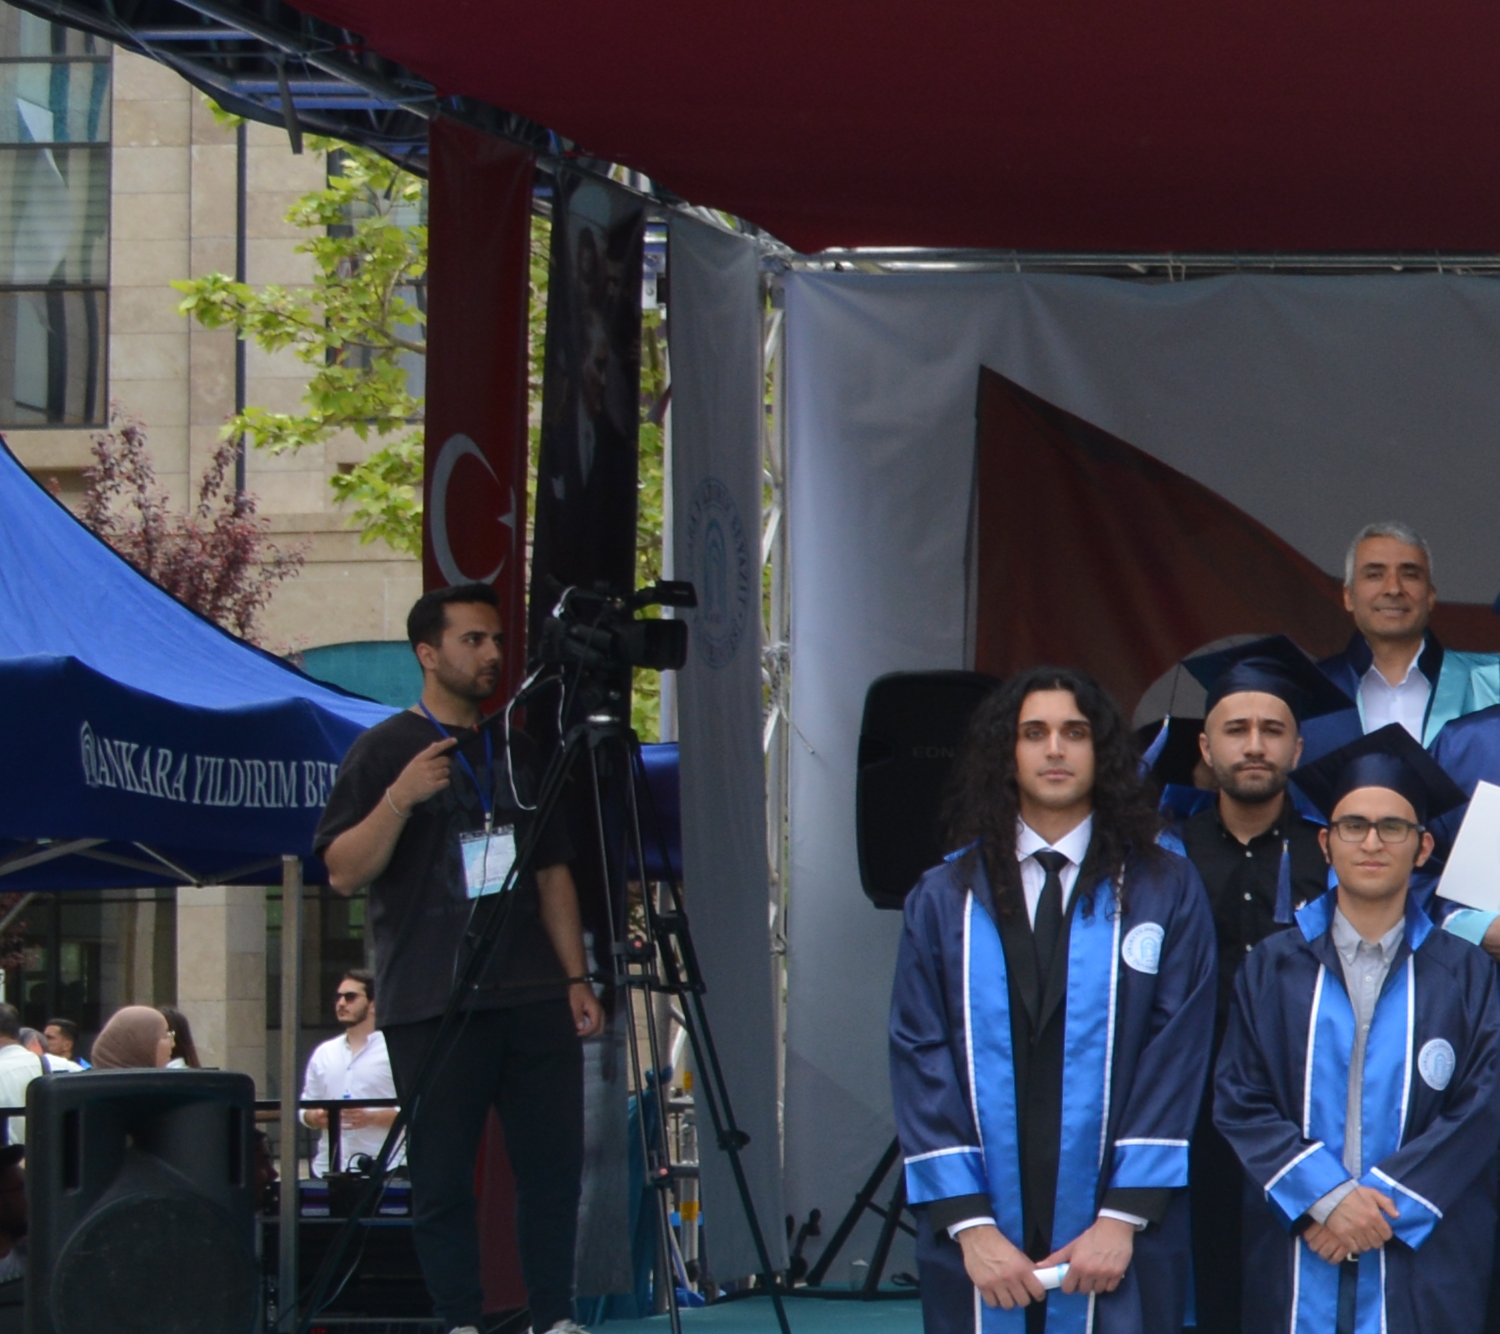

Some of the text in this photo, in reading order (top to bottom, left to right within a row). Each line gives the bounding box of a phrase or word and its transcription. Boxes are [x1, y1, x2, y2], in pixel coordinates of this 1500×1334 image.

[96, 737, 187, 803] ANKARA
[192, 754, 299, 809] YILDIRIM
[912, 746, 955, 758] EON
